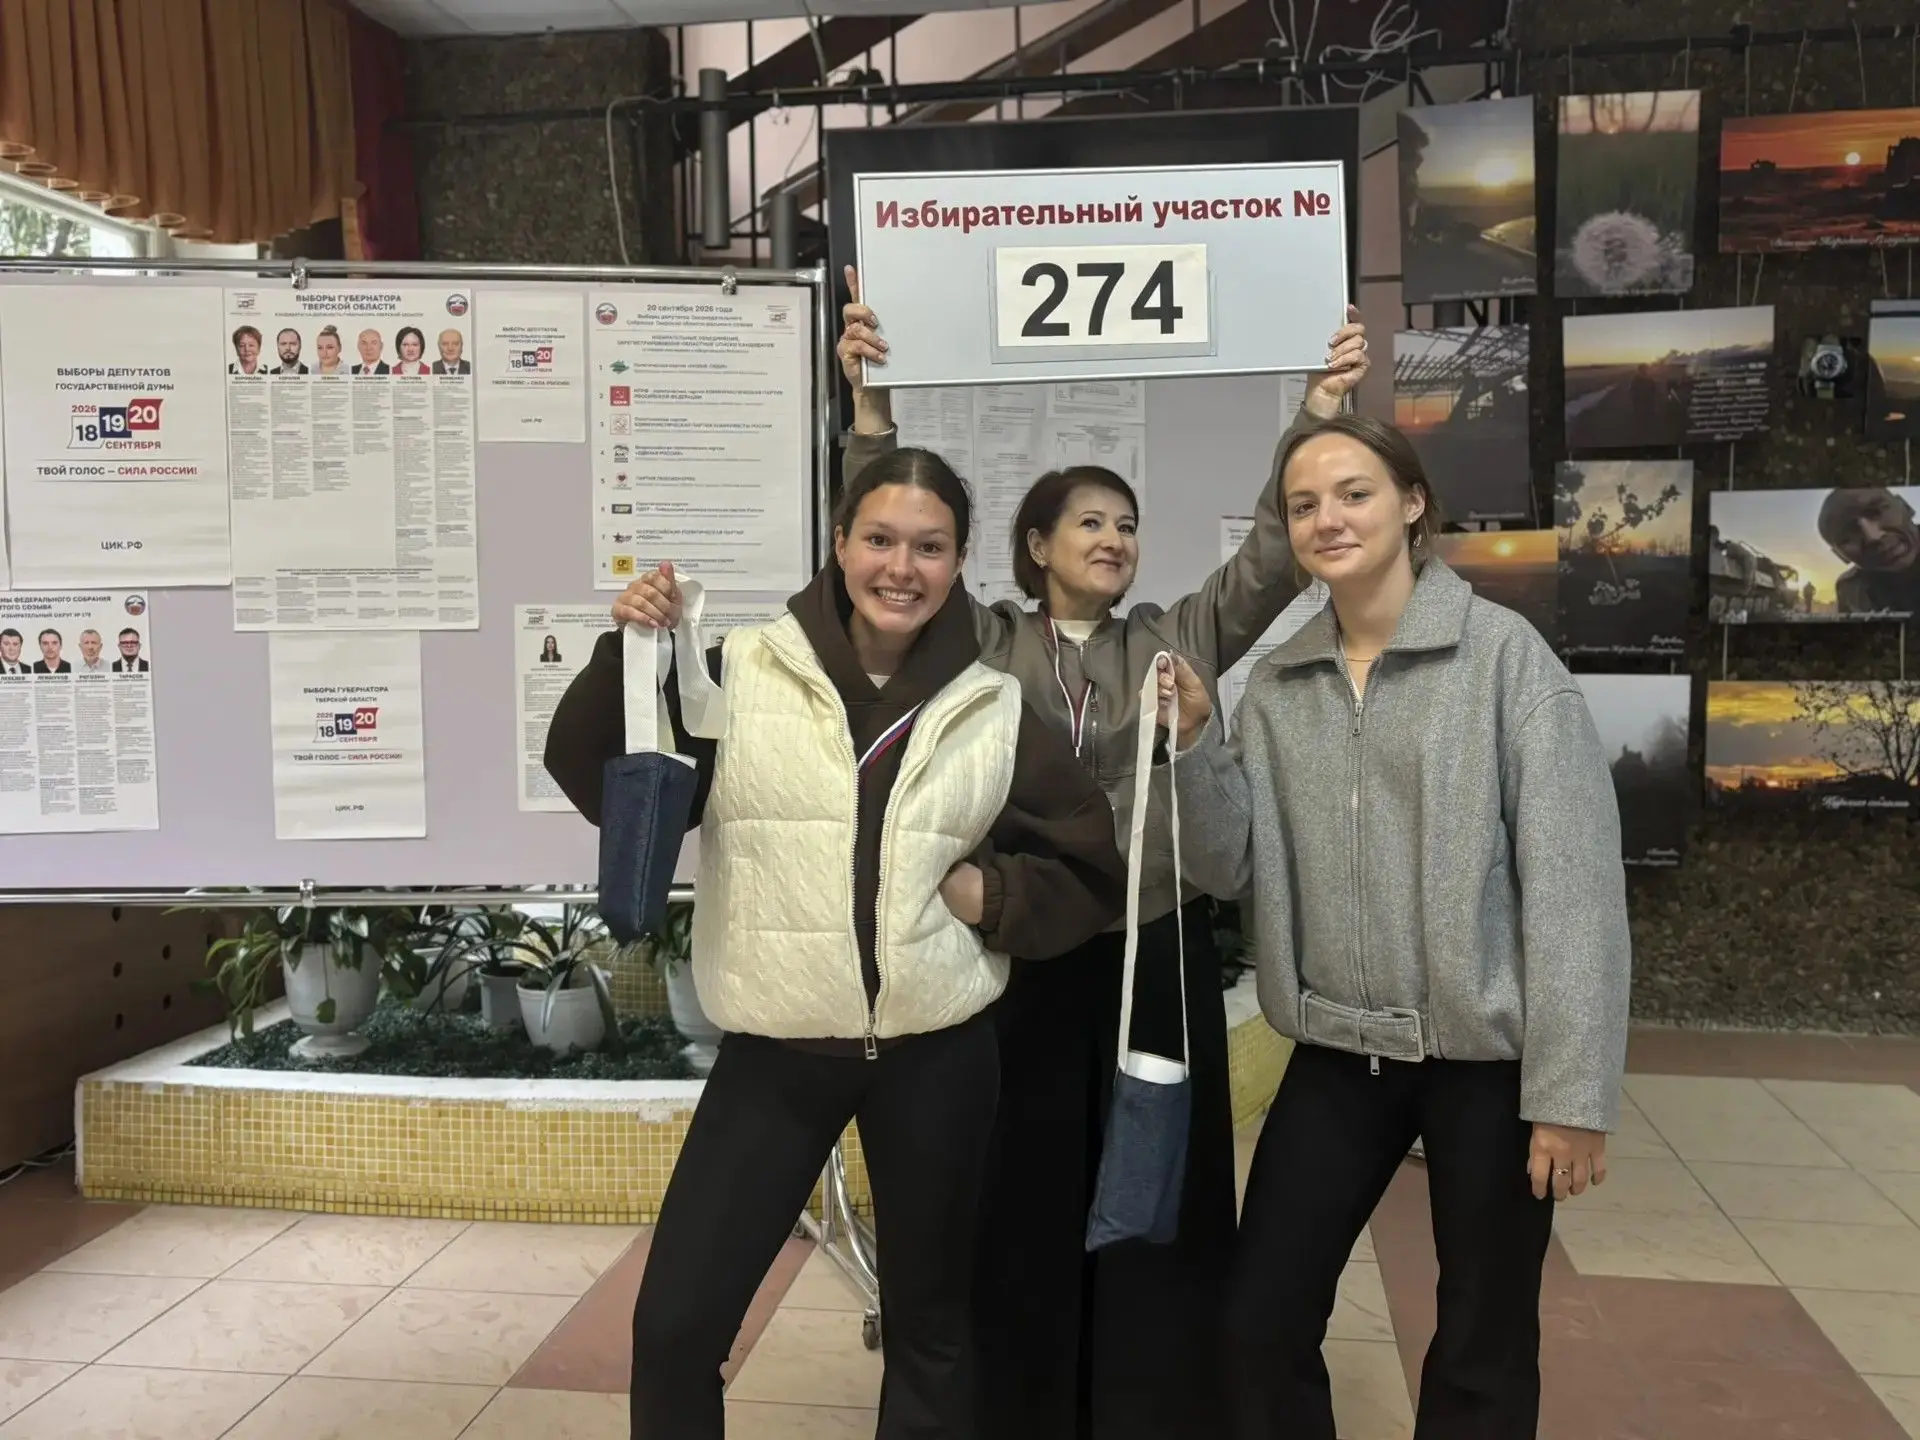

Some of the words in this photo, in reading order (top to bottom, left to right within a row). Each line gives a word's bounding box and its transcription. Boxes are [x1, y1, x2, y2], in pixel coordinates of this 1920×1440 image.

[875, 194, 1143, 234] Избирательный
[1152, 194, 1282, 229] участок
[1293, 189, 1331, 218] №
[295, 294, 336, 302] ВЫБОРЫ
[338, 294, 402, 302] ГУБЕРНАТОРА
[1020, 259, 1184, 338] 274
[302, 302, 351, 311] ТВЕРСКОЙ
[353, 302, 396, 311] ОБЛАСТИ
[511, 359, 522, 369] 18
[524, 354, 535, 364] 19
[537, 350, 551, 360] 20
[57, 367, 105, 377] ВЫБОРЫ
[107, 367, 171, 377] ДЕПУТАТОВ
[55, 382, 145, 391] ГОСУДАРСТВЕННОЙ
[146, 383, 175, 391] ДУМЫ
[71, 405, 97, 413] 2026
[75, 424, 98, 442] 18
[102, 414, 125, 433] 19
[129, 405, 157, 424] 20
[105, 441, 162, 450] СЕНТЯБРЯ
[36, 465, 68, 475] ТВОЙ
[69, 466, 105, 475] ГОЛОС
[117, 466, 147, 475] СИЛА
[149, 466, 198, 475] РОССИИ!
[100, 541, 143, 551] ЦИК.РФ
[14, 596, 71, 604] ФЕДЕРАЛЬНОГО
[72, 595, 112, 603] СОБРАНИЯ
[319, 726, 335, 738] 18
[336, 718, 352, 732] 19
[355, 712, 375, 725] 20
